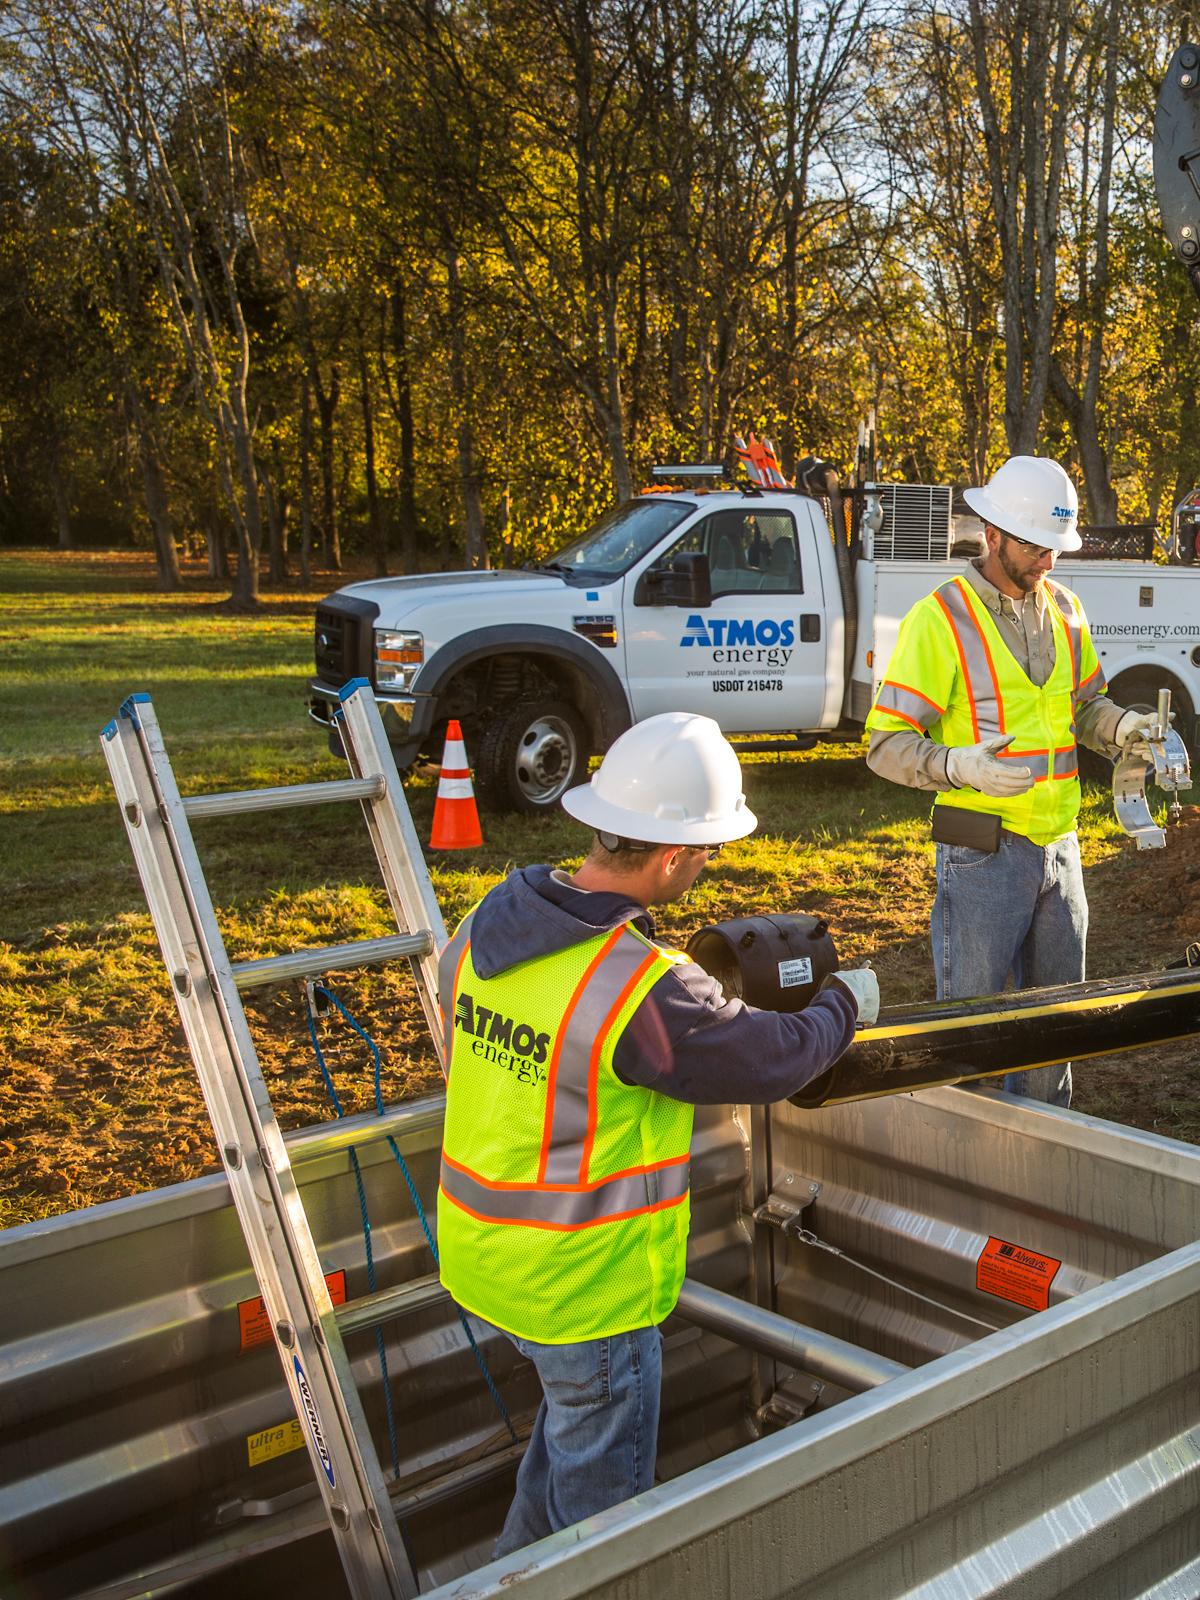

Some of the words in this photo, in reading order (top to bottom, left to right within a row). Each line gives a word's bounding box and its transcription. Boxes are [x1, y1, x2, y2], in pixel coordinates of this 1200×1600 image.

[1051, 506, 1075, 517] ATMO
[680, 615, 795, 647] ATMOS
[1090, 622, 1200, 639] tmosenergy.com
[713, 648, 794, 667] energy
[686, 670, 704, 678] your
[707, 668, 736, 677] natural
[752, 669, 786, 677] company
[713, 680, 744, 692] USDOT
[747, 680, 783, 691] 216478
[455, 992, 551, 1064] ATMOS
[472, 1039, 544, 1086] energy
[301, 1381, 329, 1461] WERNER
[250, 1430, 285, 1449] ultra
[291, 1421, 301, 1433] S
